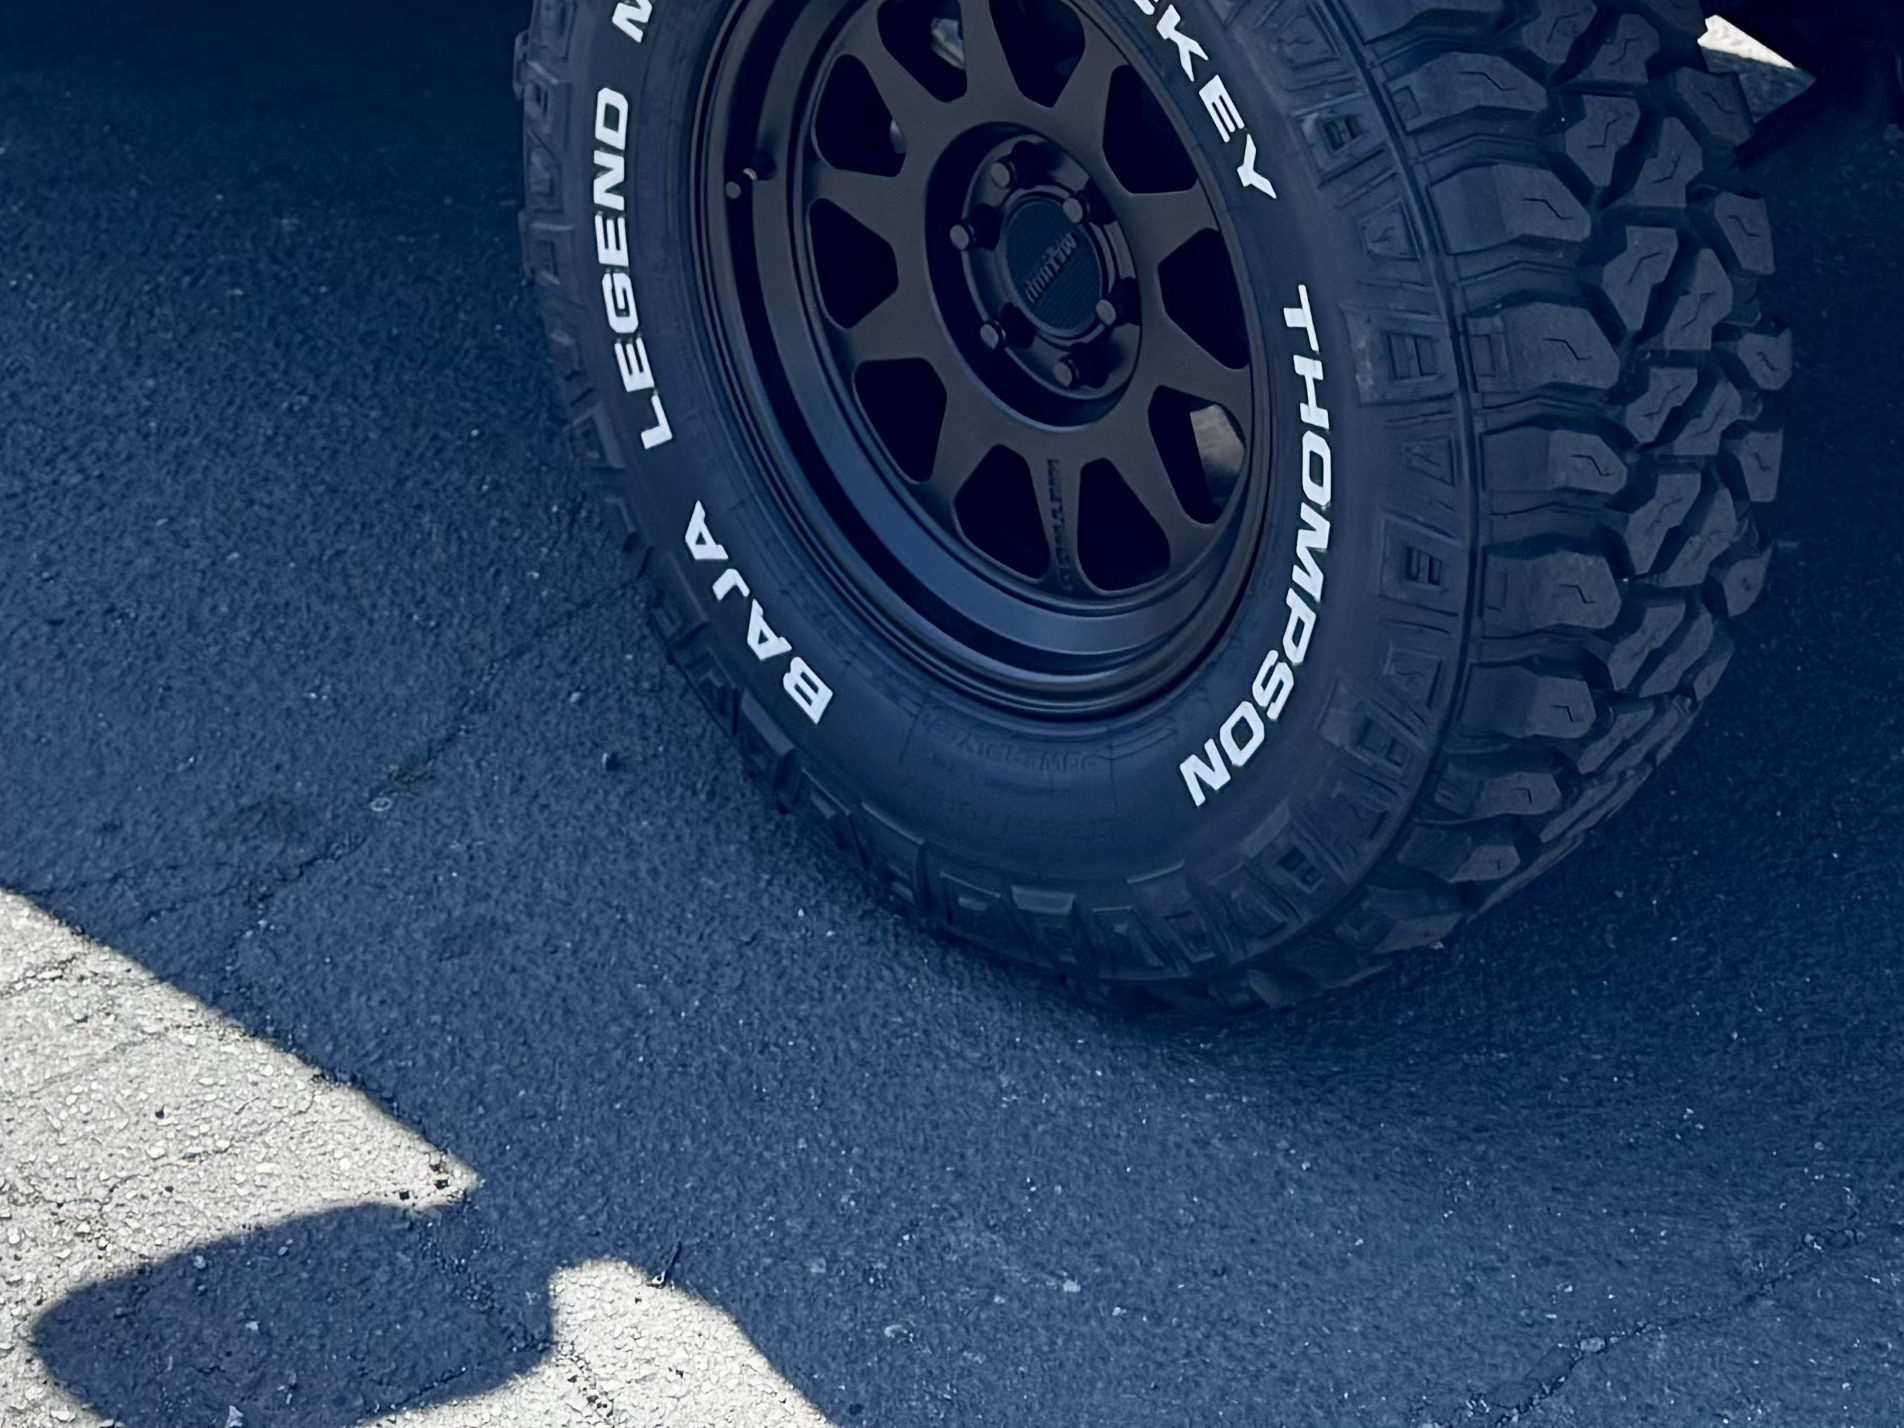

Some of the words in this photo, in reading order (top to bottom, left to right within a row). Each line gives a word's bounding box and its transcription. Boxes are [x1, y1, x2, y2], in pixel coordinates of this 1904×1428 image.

[592, 86, 673, 449] LEGEND
[684, 500, 833, 724] BAJA
[1179, 283, 1333, 807] THOMPSON
